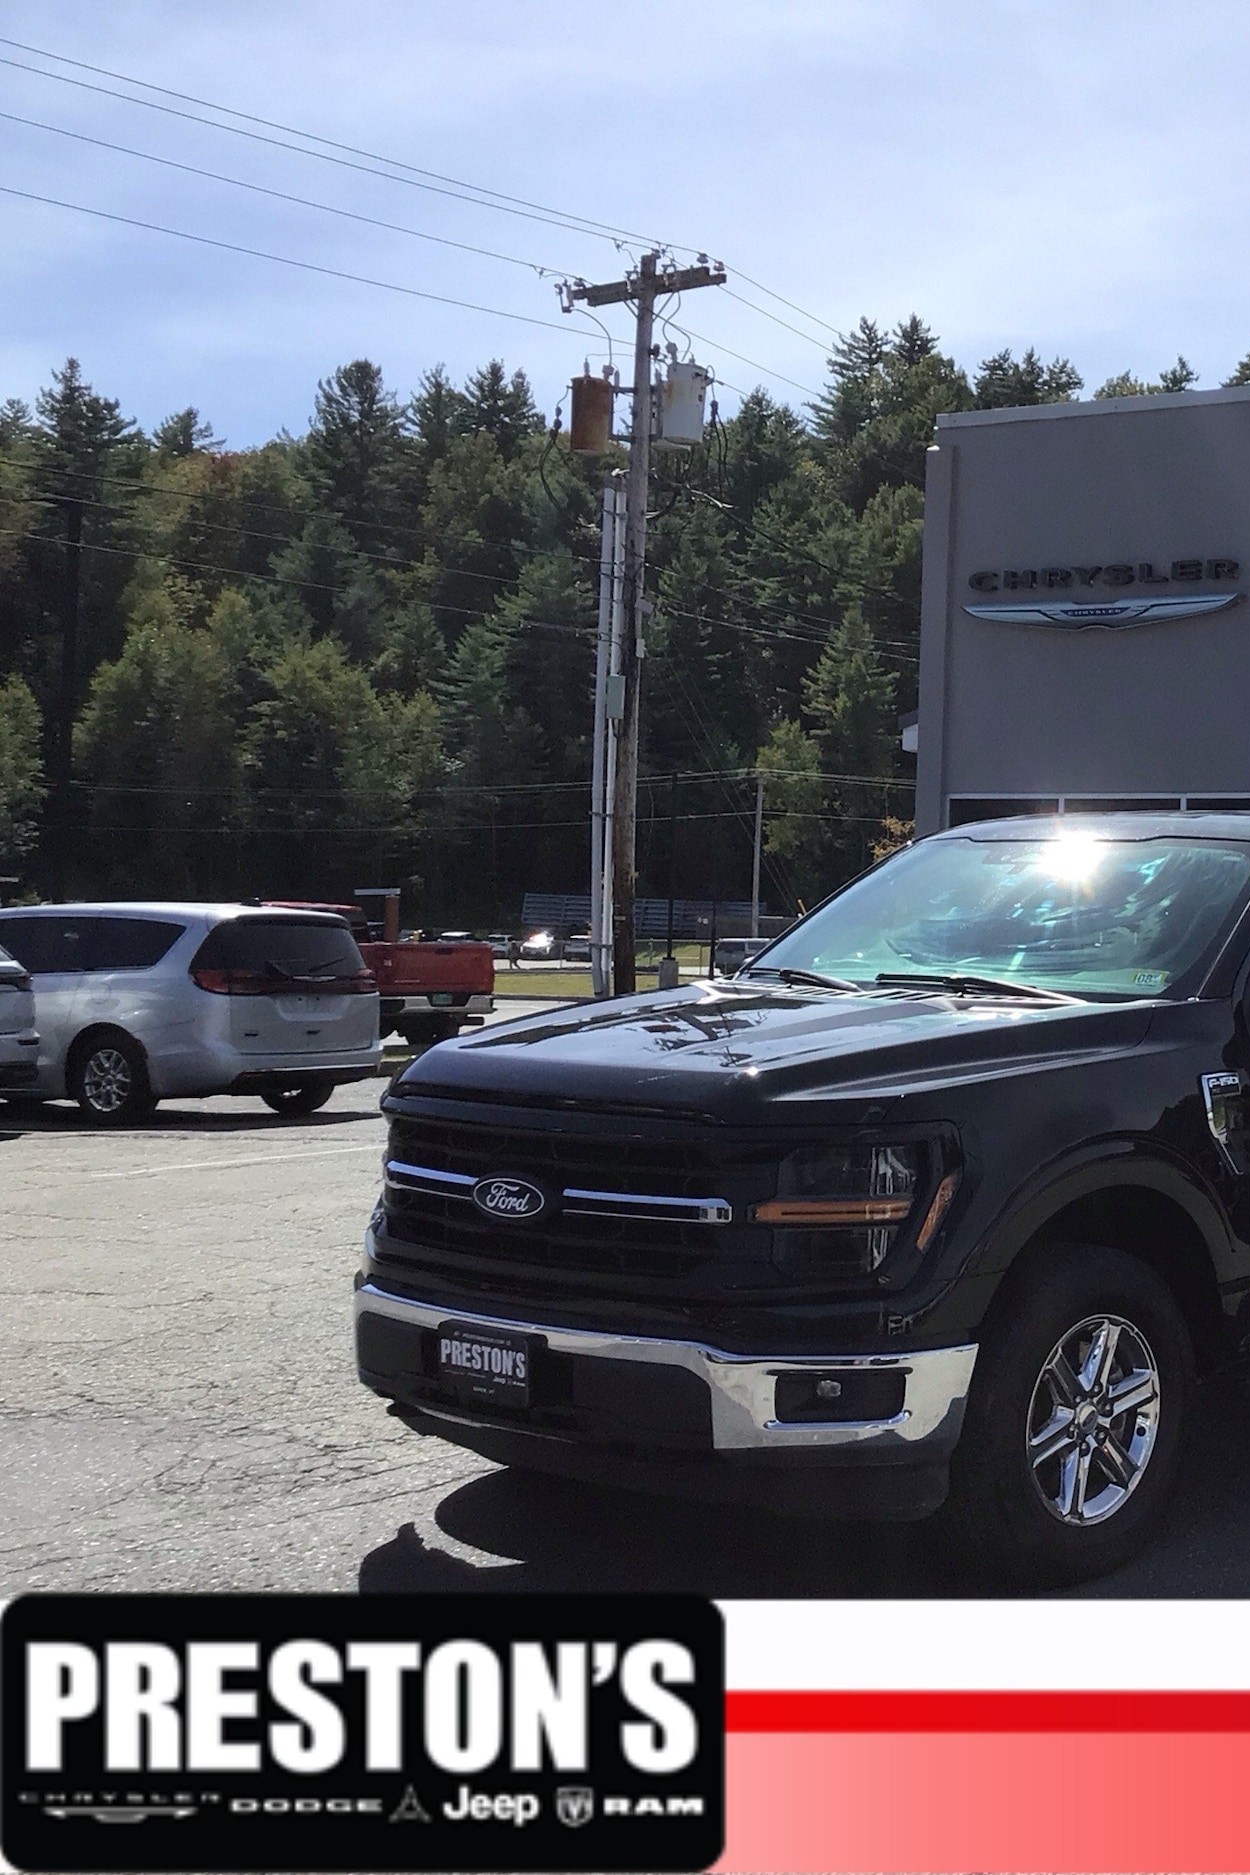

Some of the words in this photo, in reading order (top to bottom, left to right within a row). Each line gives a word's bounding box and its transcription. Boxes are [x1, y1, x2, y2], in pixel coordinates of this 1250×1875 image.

[968, 559, 1240, 592] CHRYSLER
[486, 1182, 530, 1212] Ford
[441, 1338, 526, 1379] PRESTON'S
